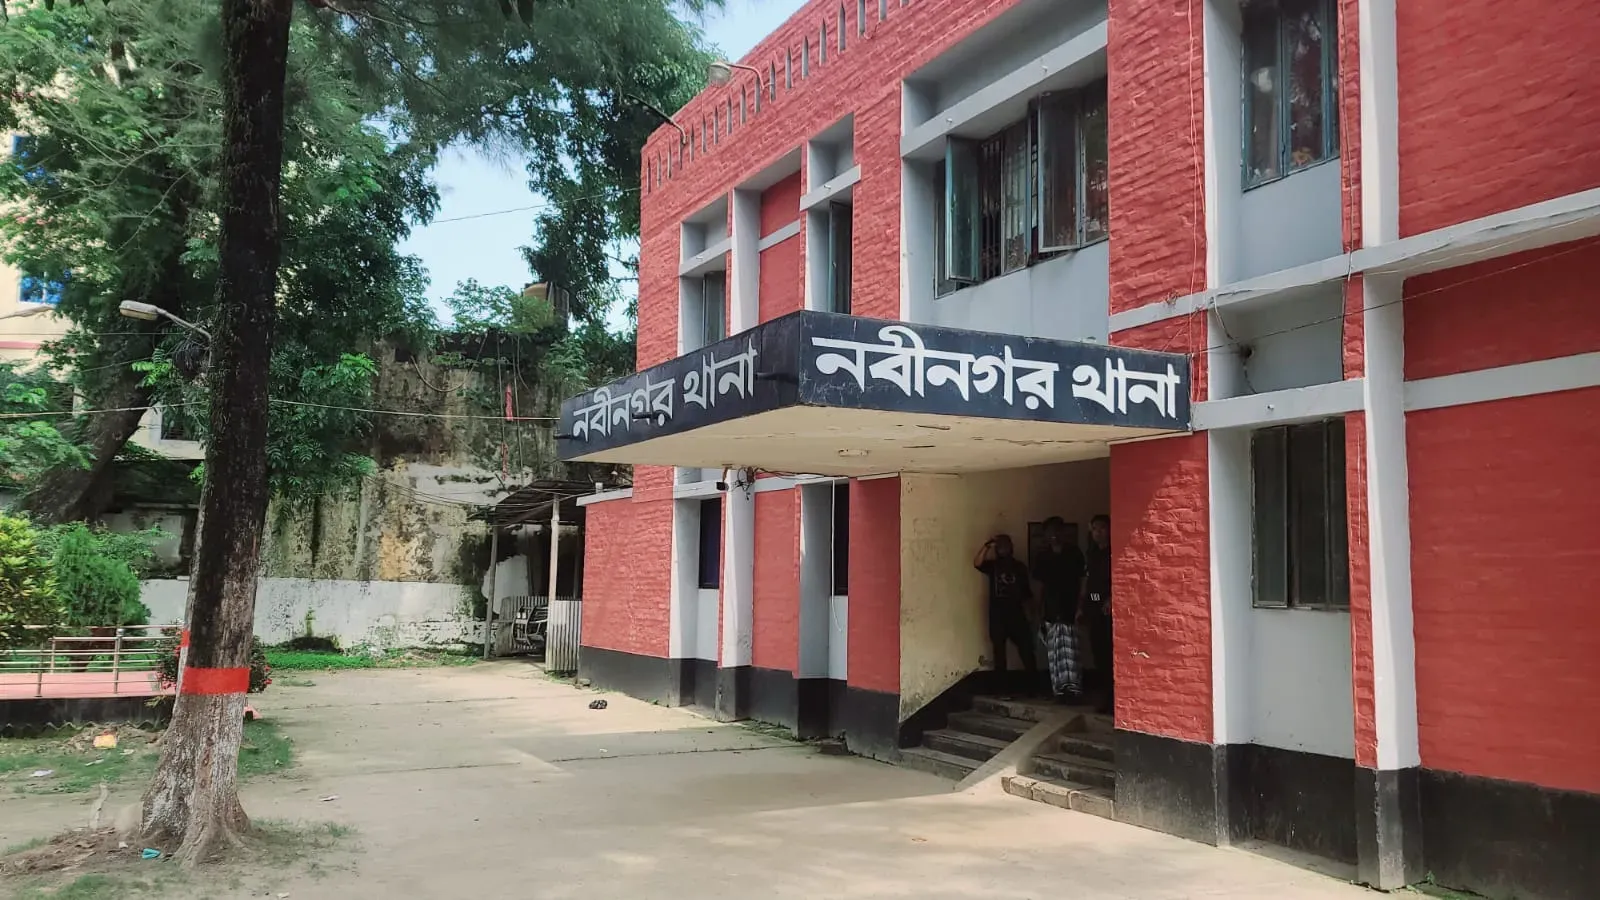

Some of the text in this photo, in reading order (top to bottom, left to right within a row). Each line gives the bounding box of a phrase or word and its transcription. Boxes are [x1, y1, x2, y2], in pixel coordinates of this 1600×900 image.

[572, 338, 758, 442] নবীনগর থানা
[811, 325, 1180, 418] নবীনগর থানা
